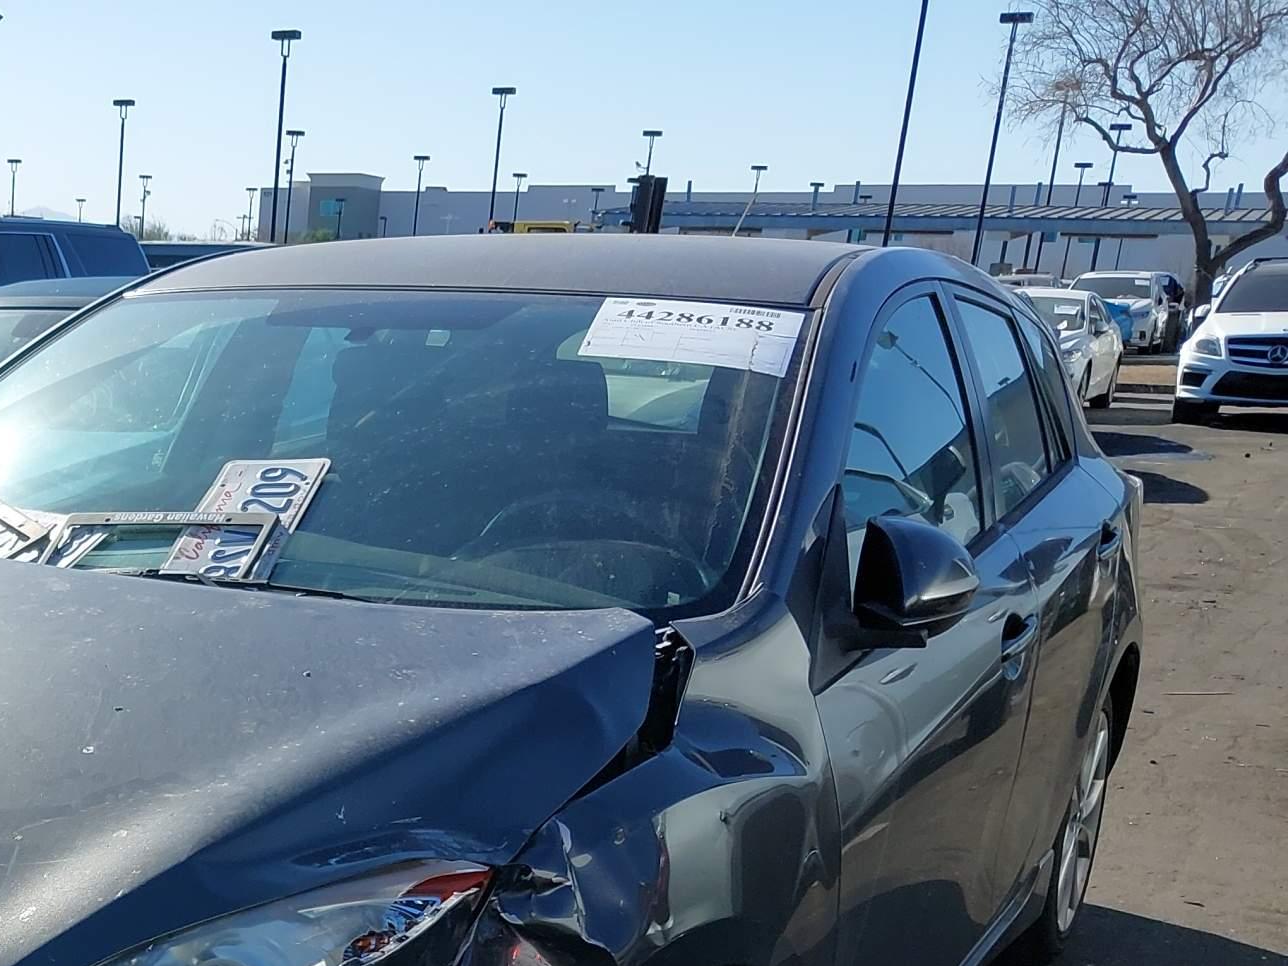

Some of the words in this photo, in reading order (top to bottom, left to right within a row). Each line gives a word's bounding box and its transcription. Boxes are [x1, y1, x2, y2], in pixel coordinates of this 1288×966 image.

[617, 309, 775, 332] 44286188
[113, 511, 164, 523] Gardens
[167, 511, 225, 524] Hawaiian
